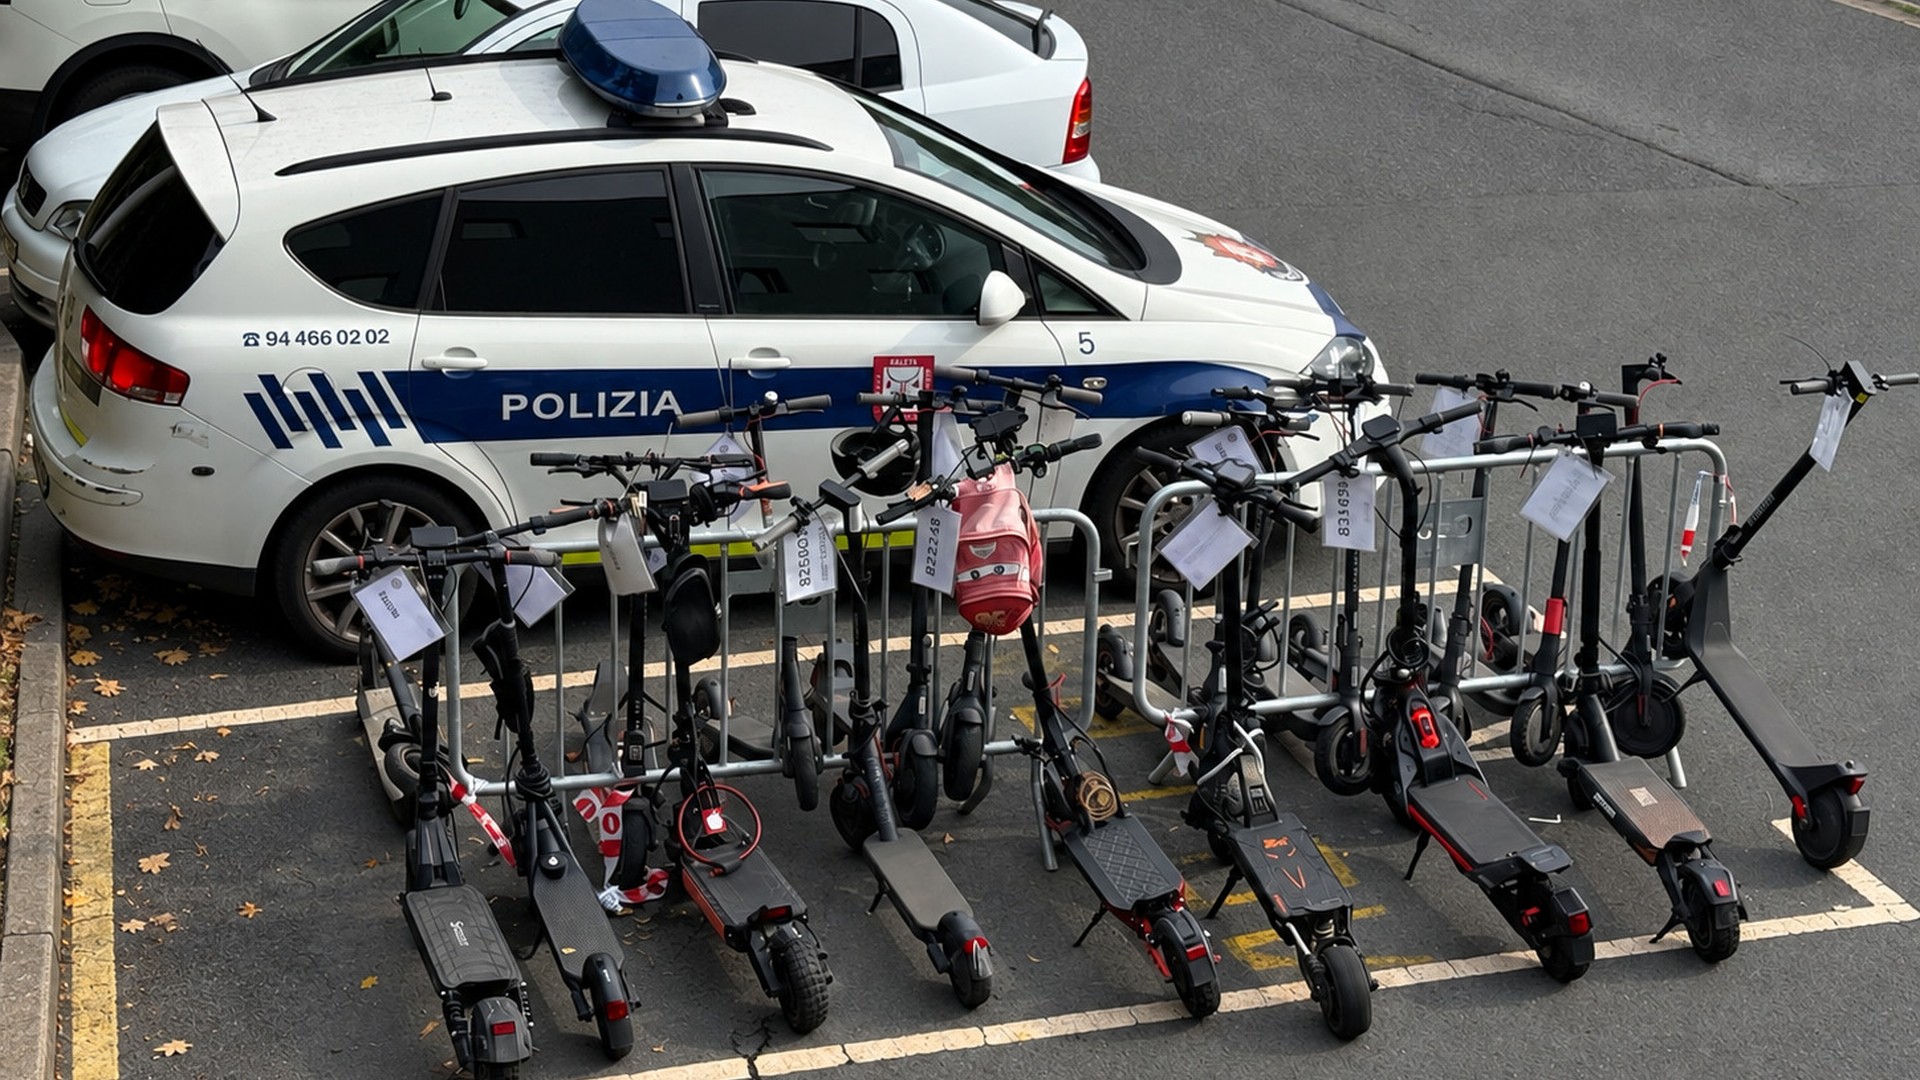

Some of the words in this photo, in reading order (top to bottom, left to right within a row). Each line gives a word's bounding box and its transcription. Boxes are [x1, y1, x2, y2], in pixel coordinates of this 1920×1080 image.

[265, 331, 290, 346] 94
[295, 330, 332, 346] 466
[336, 329, 361, 345] 02
[365, 328, 390, 345] 02
[1078, 331, 1095, 355] 5
[502, 389, 683, 421] POLIZIA
